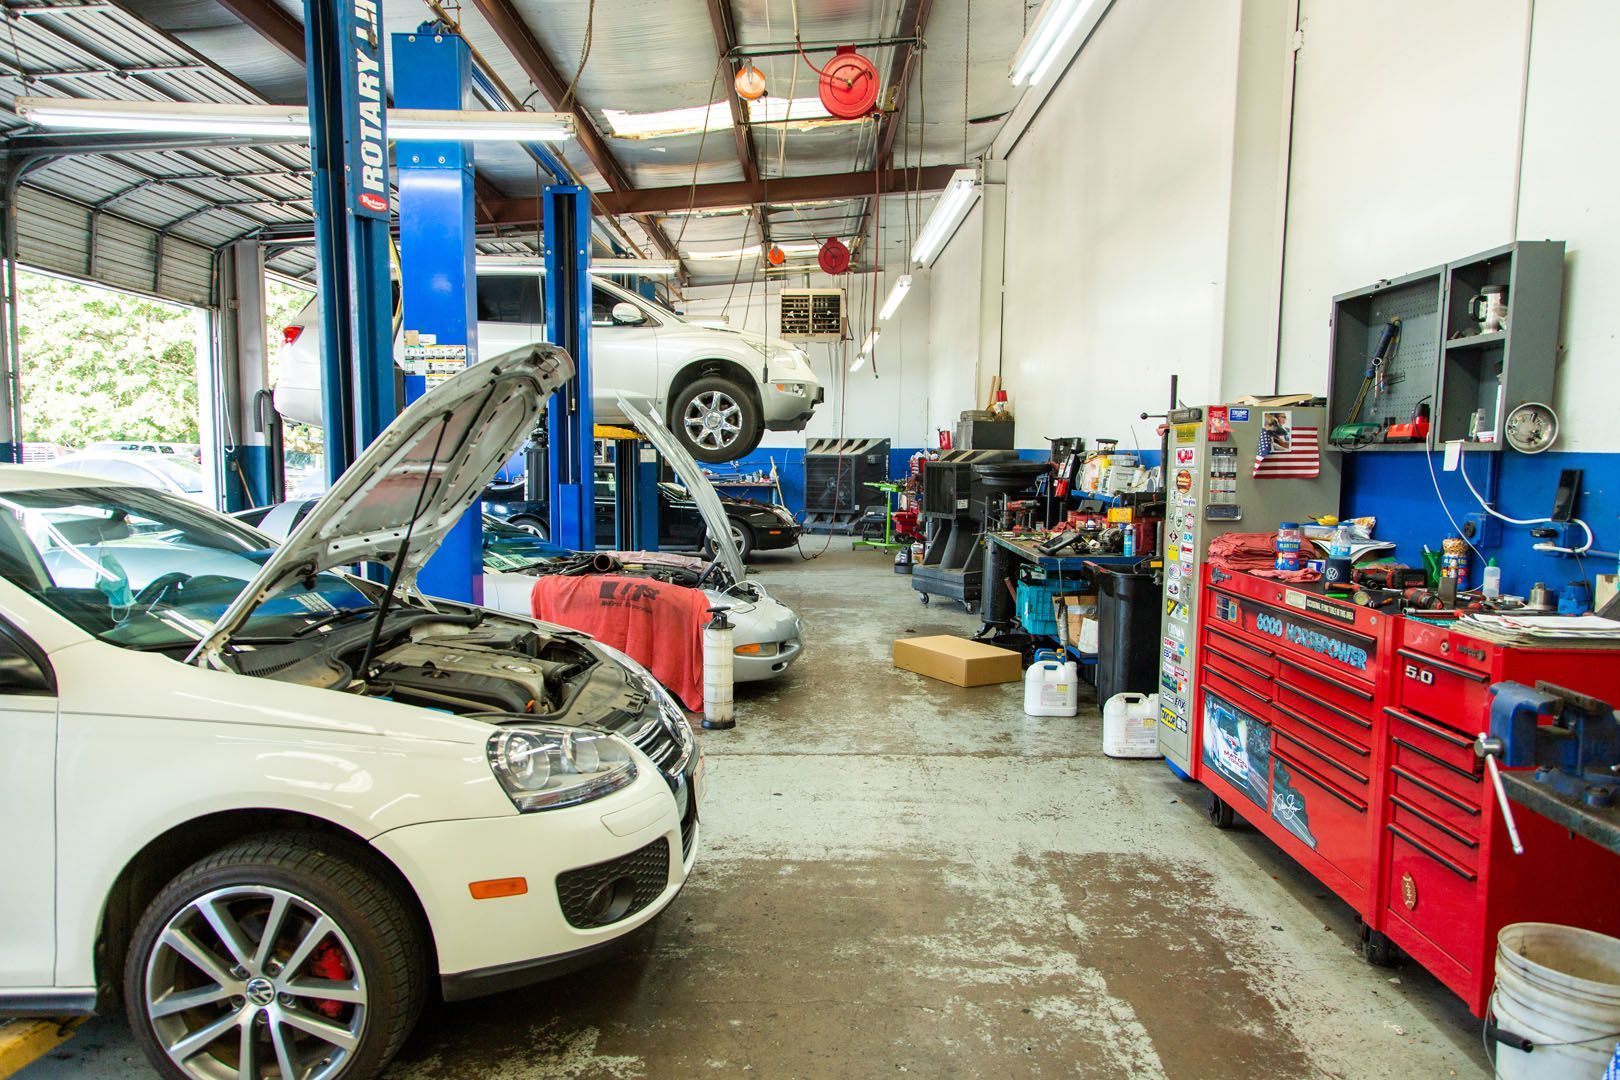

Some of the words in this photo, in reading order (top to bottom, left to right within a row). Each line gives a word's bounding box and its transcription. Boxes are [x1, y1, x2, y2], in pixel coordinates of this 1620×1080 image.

[357, 49, 384, 193] ROTARY
[1257, 612, 1283, 637] 6000
[1286, 622, 1368, 671] HORSEPOWER
[1405, 664, 1433, 685] 5.0
